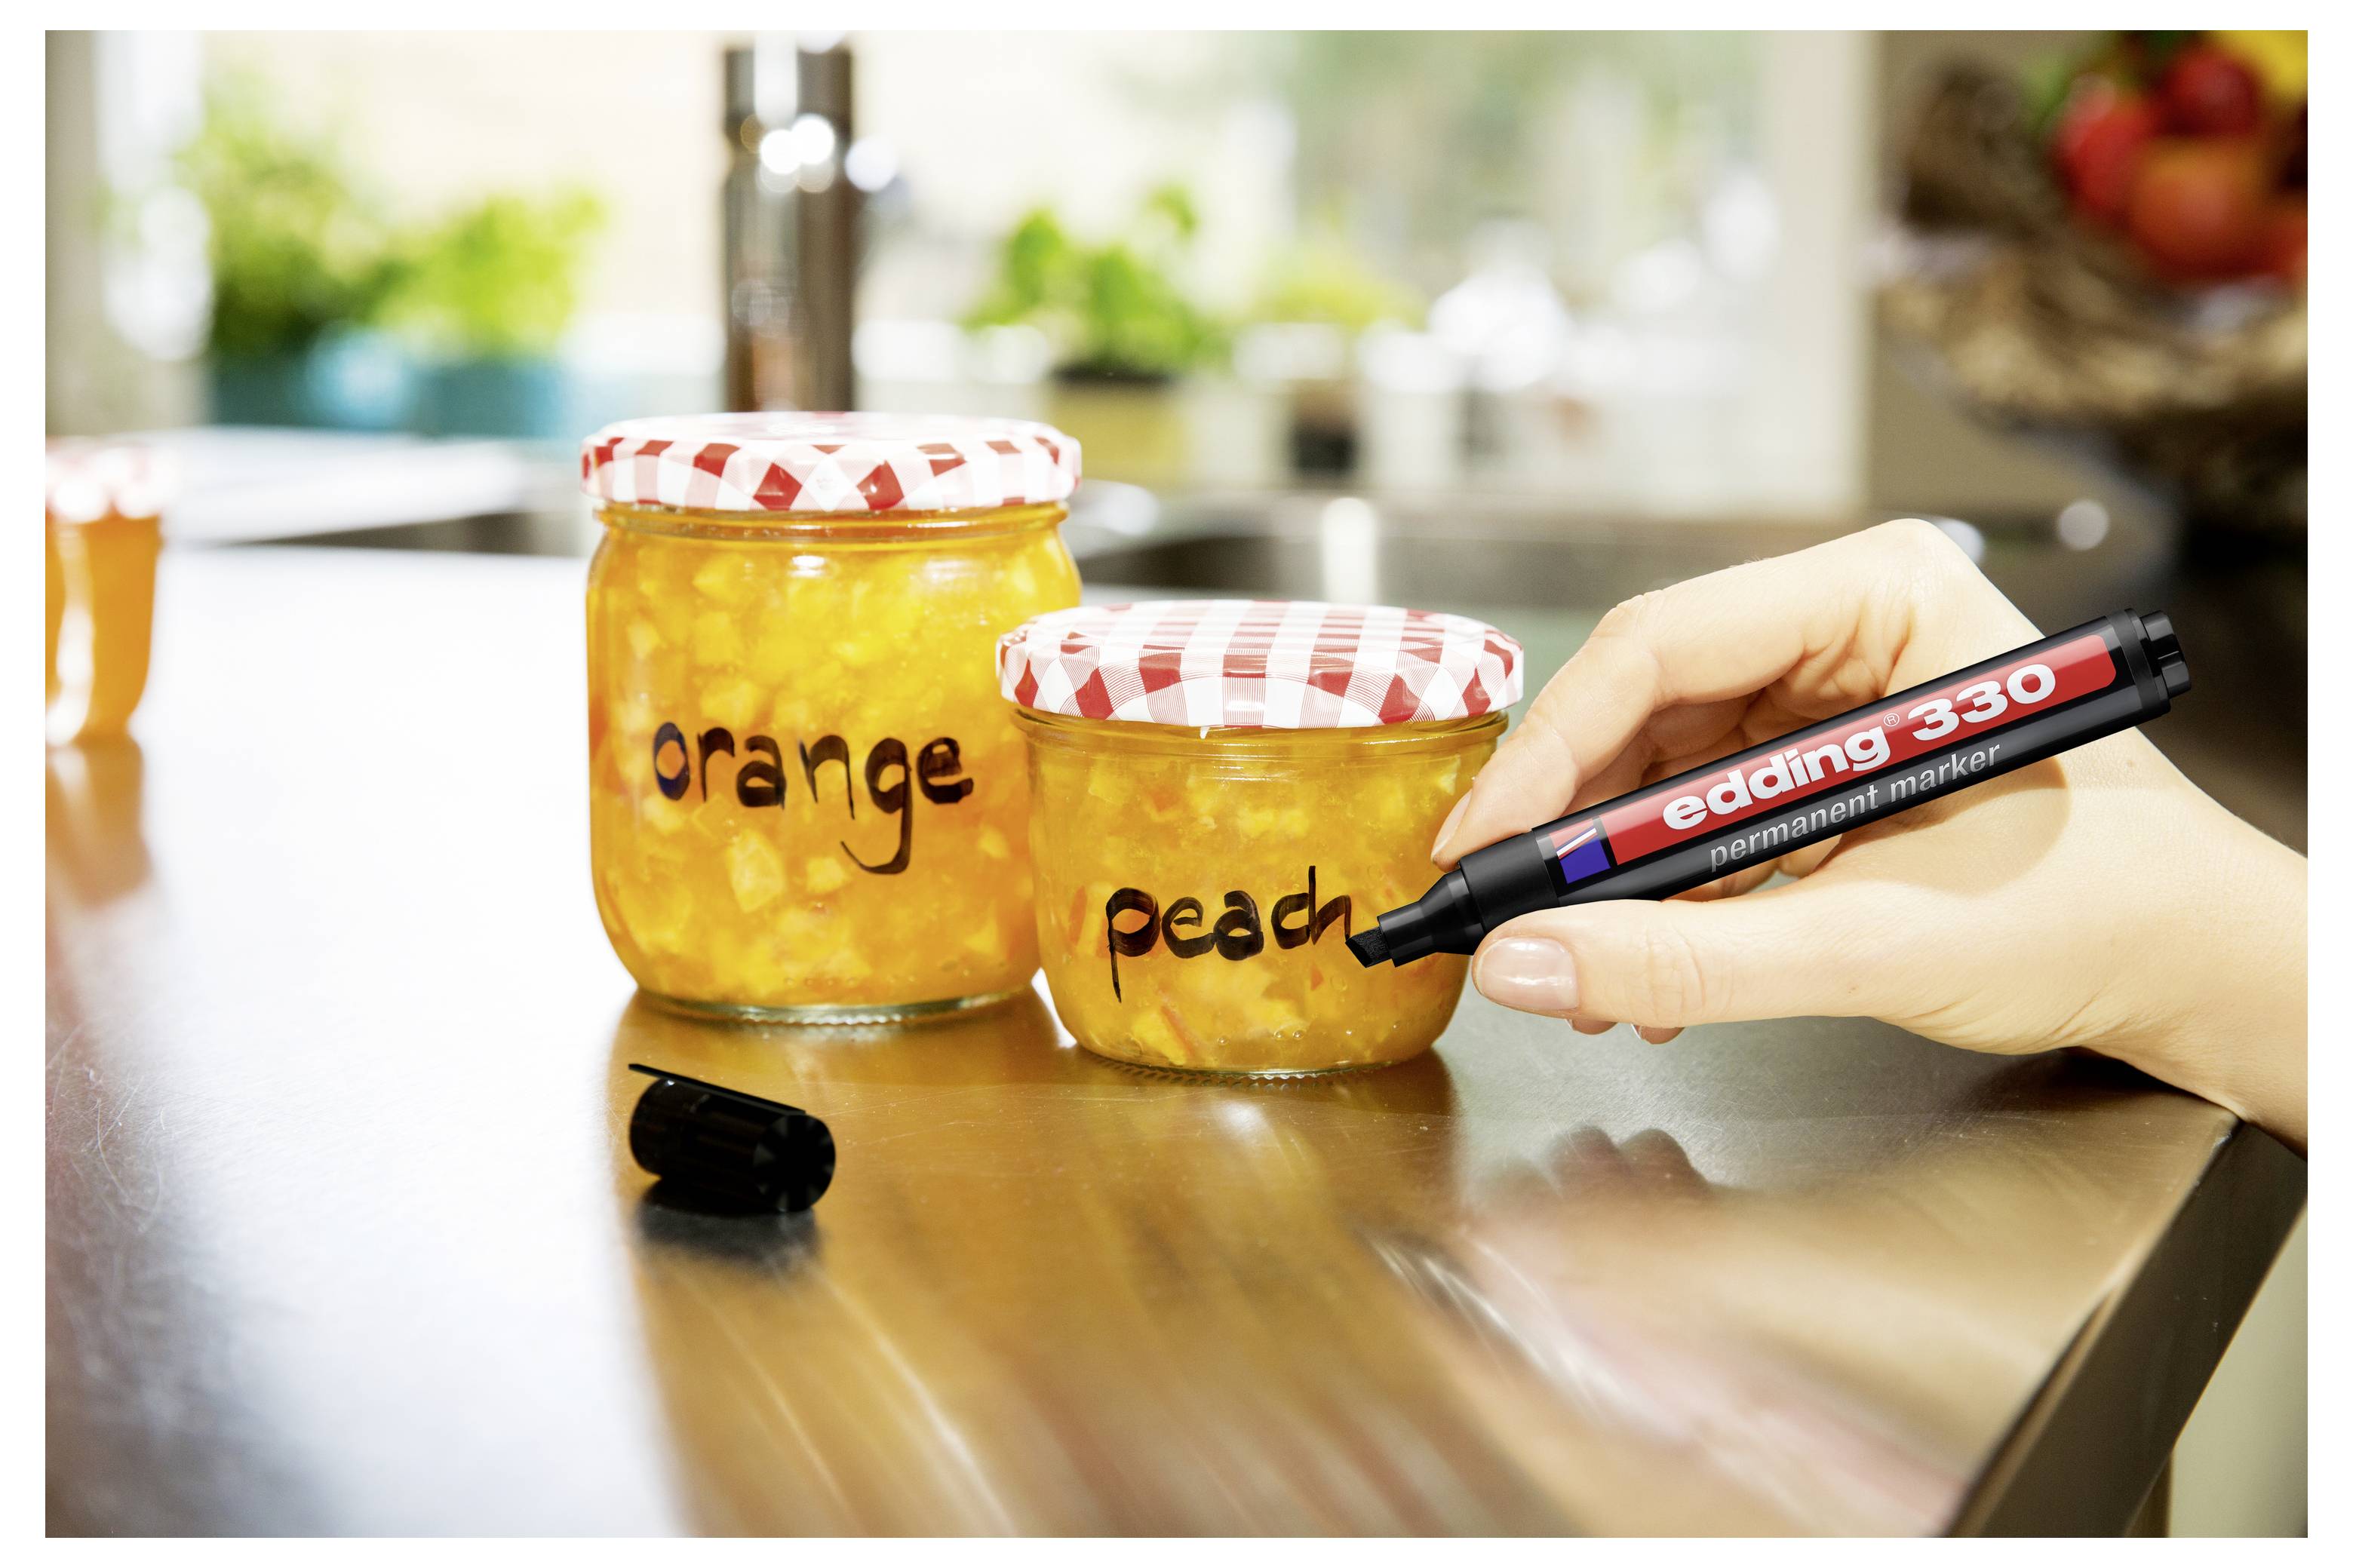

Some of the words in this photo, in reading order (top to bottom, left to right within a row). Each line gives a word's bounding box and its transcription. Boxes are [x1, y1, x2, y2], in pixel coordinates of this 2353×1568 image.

[1908, 664, 2056, 741] 330
[653, 722, 973, 874] orange
[1709, 785, 1879, 872] permanent
[1891, 744, 2001, 796] marker
[1106, 866, 1351, 1003] peach
